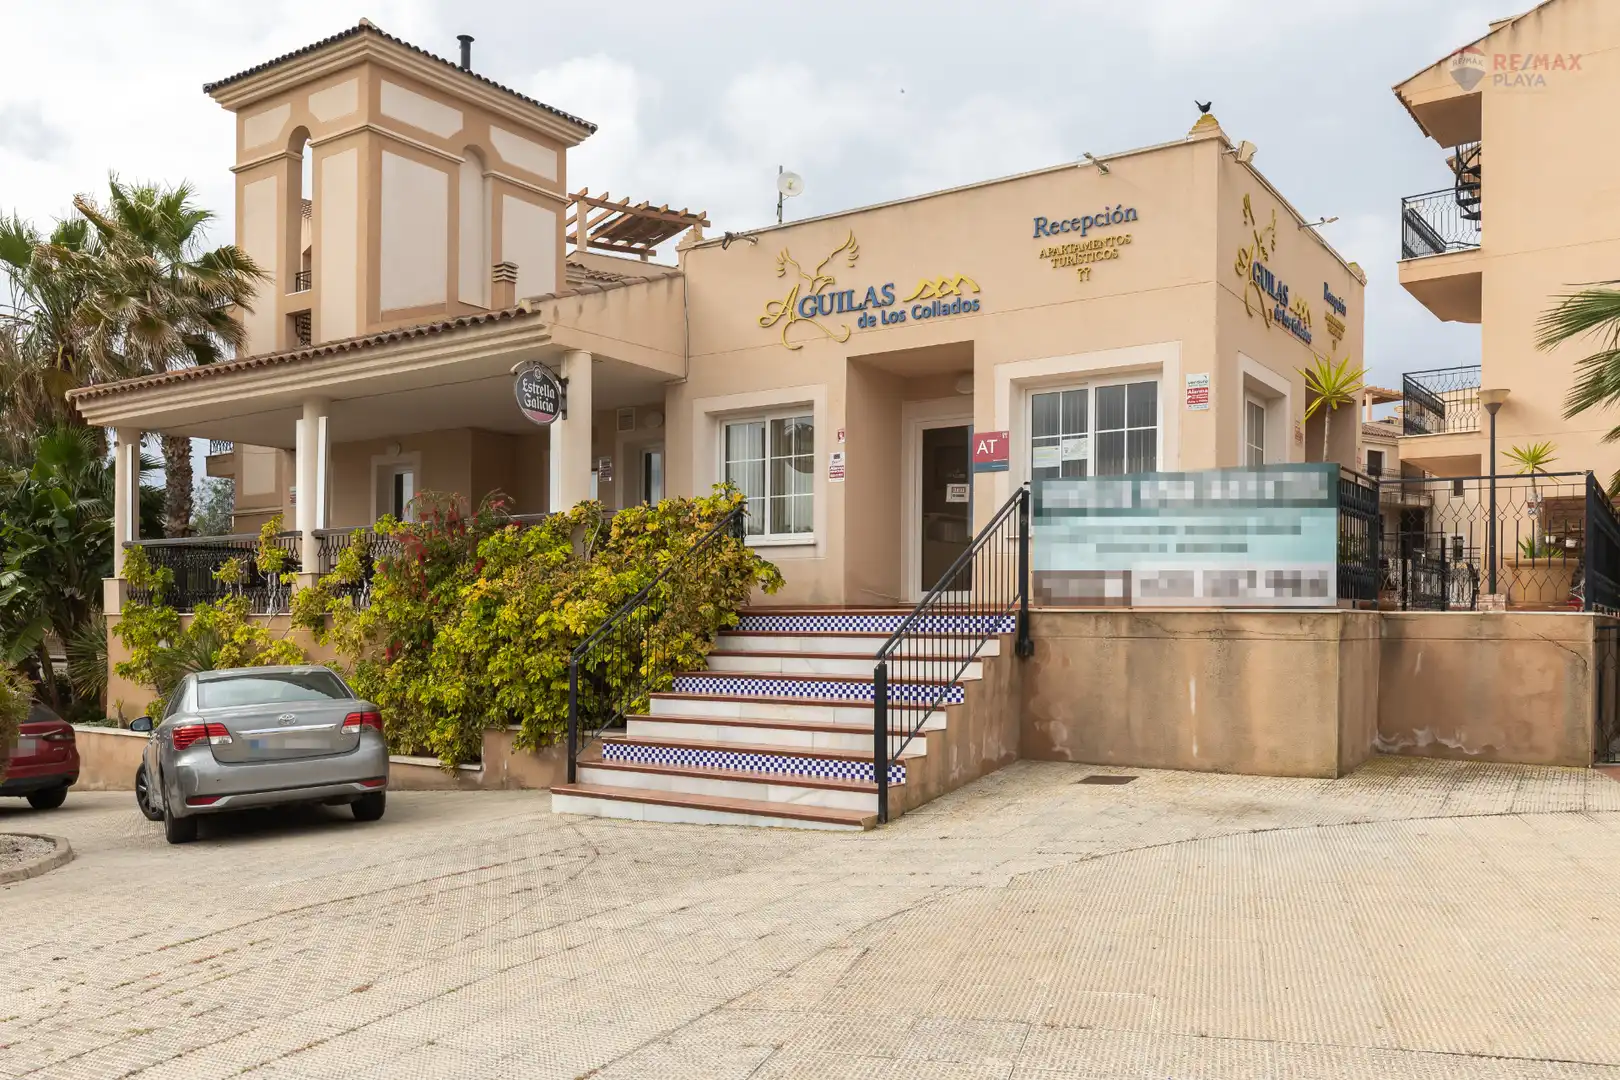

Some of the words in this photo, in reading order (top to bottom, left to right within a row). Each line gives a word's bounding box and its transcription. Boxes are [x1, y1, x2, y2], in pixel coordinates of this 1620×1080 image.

[1033, 204, 1138, 238] Recepción
[1039, 234, 1132, 259] APARTAMENTOS
[857, 311, 877, 328] de
[881, 308, 906, 325] Los
[911, 298, 980, 319] Collados
[522, 378, 555, 399] Estrella
[523, 393, 554, 412] Galicia
[976, 439, 998, 454] AT
